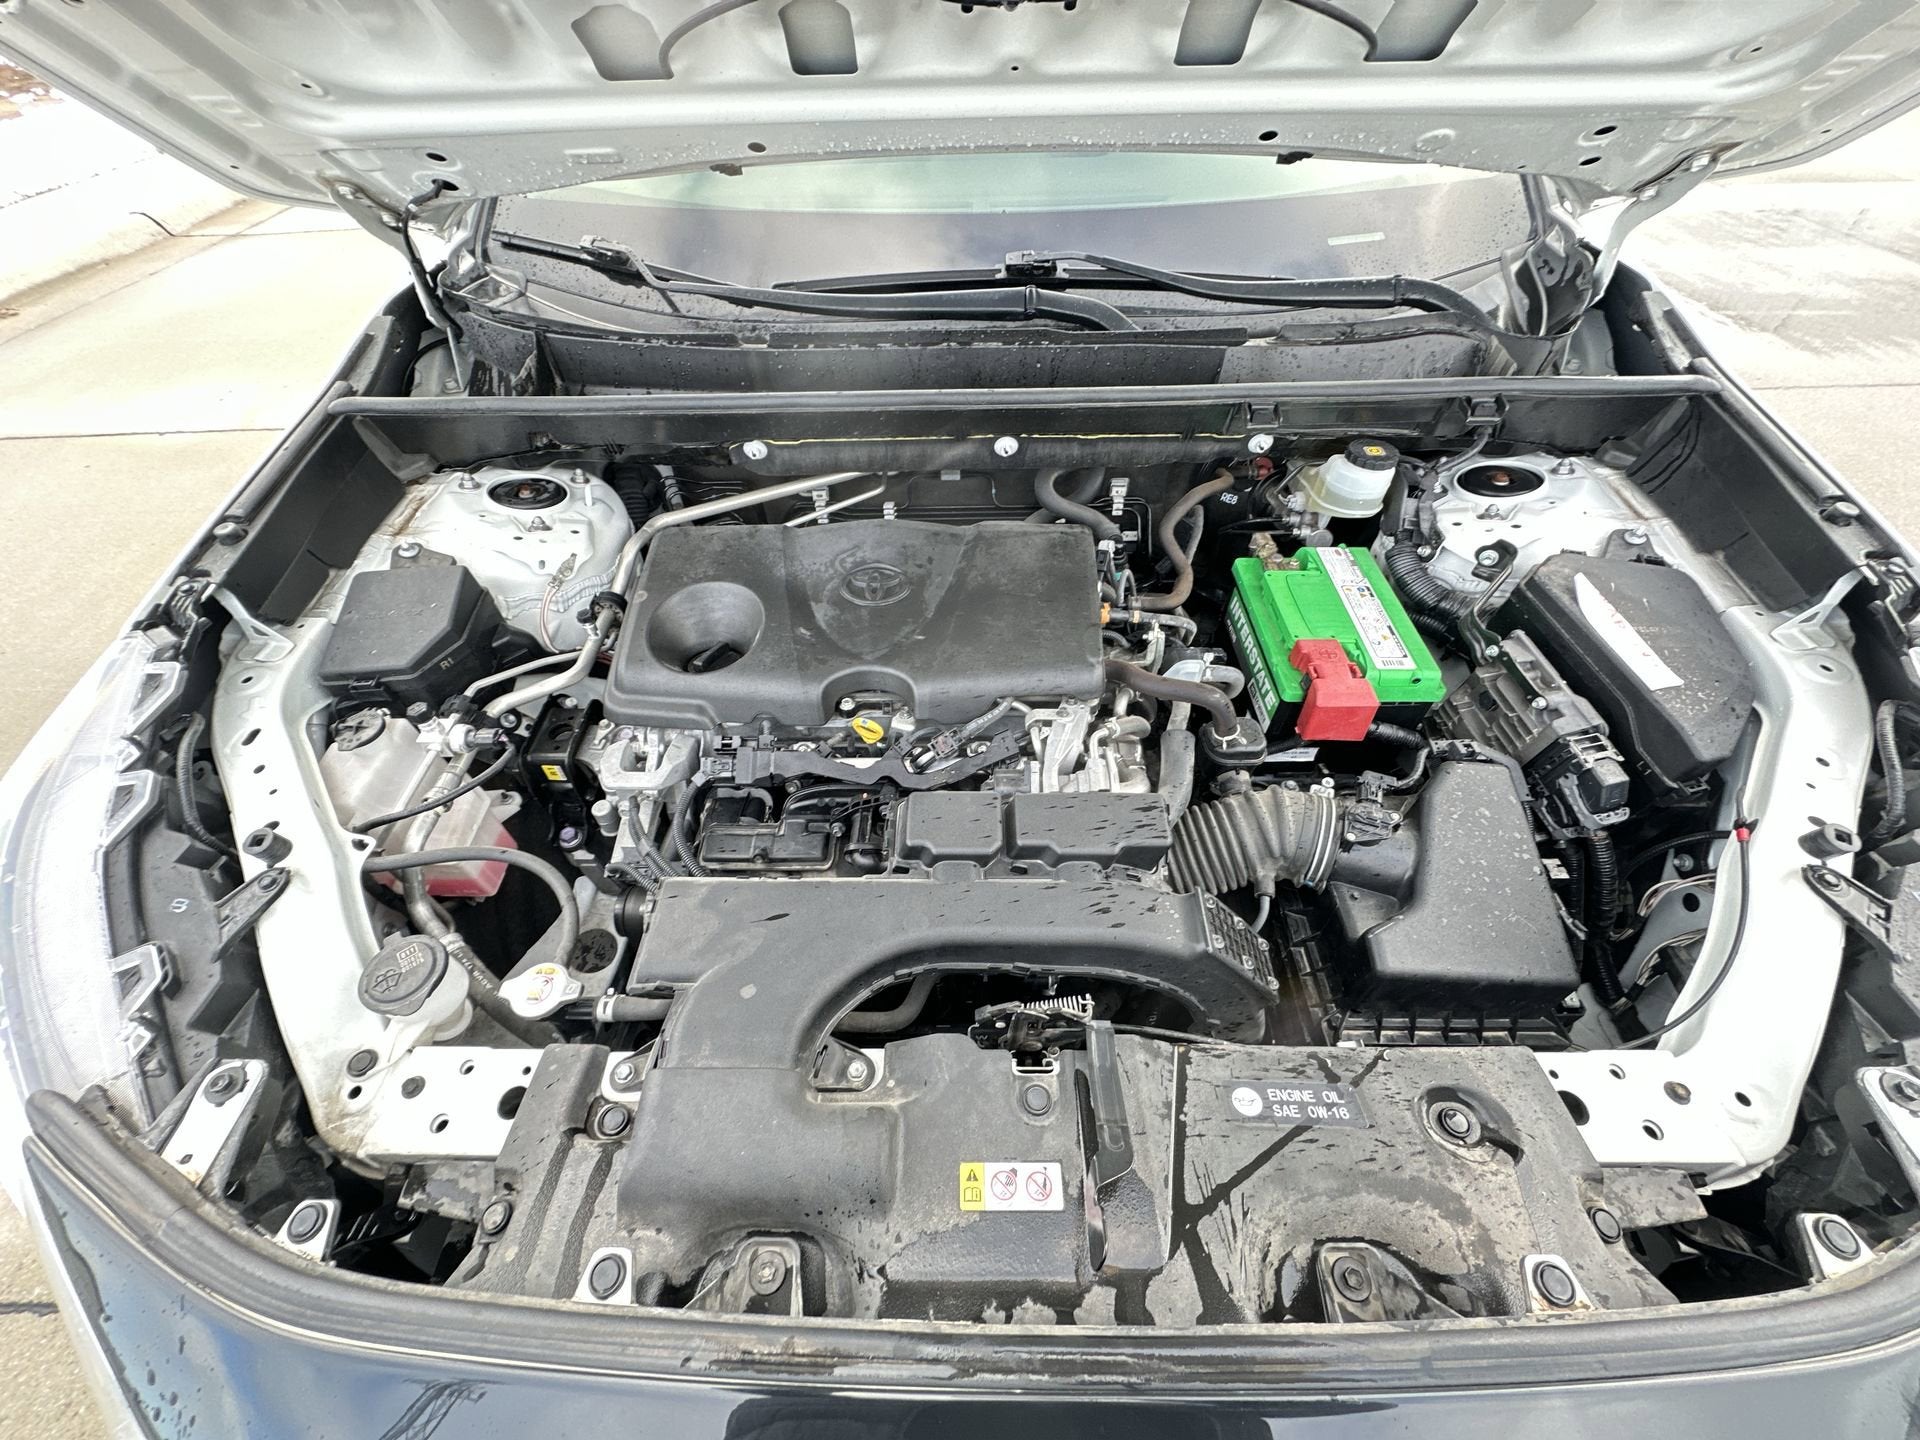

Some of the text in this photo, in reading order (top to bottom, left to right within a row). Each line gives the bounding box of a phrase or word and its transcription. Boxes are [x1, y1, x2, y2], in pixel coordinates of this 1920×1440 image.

[1220, 492, 1239, 504] RE8
[1230, 596, 1276, 711] INTERSTATE
[440, 657, 454, 670] R1
[1266, 1088, 1345, 1104] ENGINE OIL
[1272, 1104, 1350, 1120] SAE 0W-16
